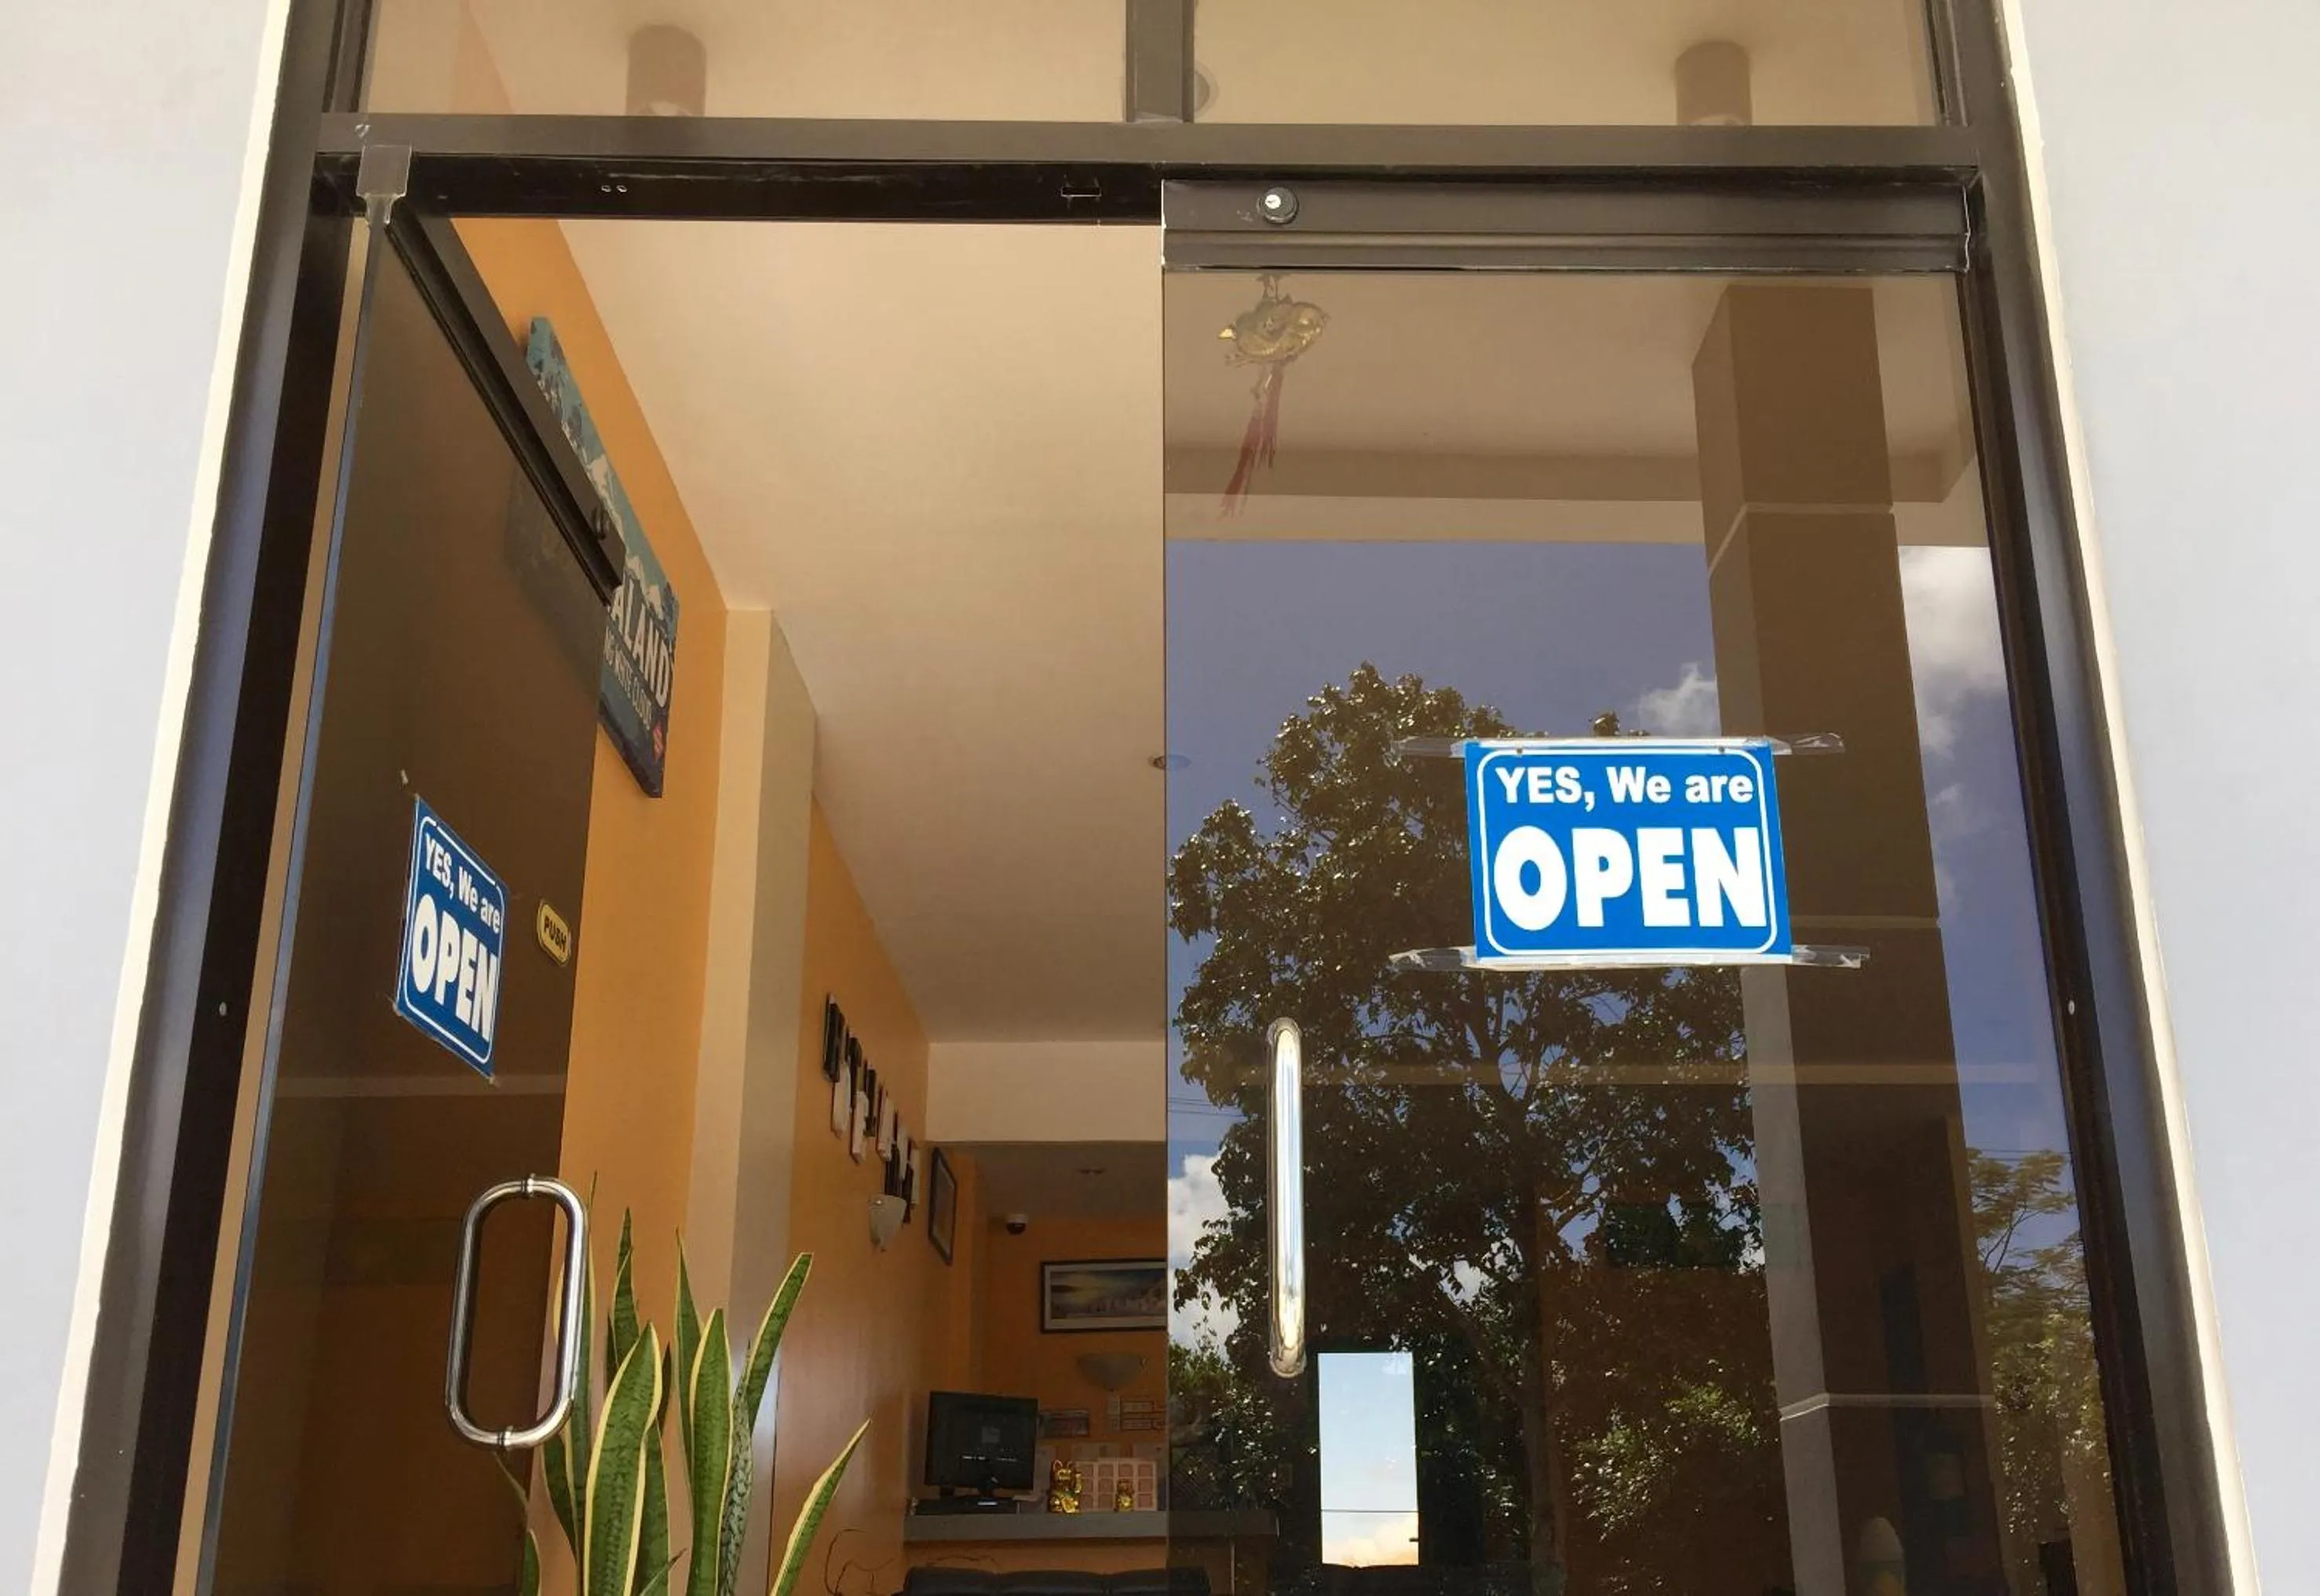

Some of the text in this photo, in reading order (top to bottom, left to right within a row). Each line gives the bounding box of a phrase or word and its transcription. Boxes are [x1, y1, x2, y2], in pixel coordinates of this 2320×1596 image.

[607, 574, 671, 708] ALAND
[1495, 766, 1753, 811] YES, We are
[425, 833, 502, 935] YES, We are
[1494, 825, 1767, 931] OPEN
[411, 894, 498, 1043] OPEN
[544, 915, 567, 953] PUSH
